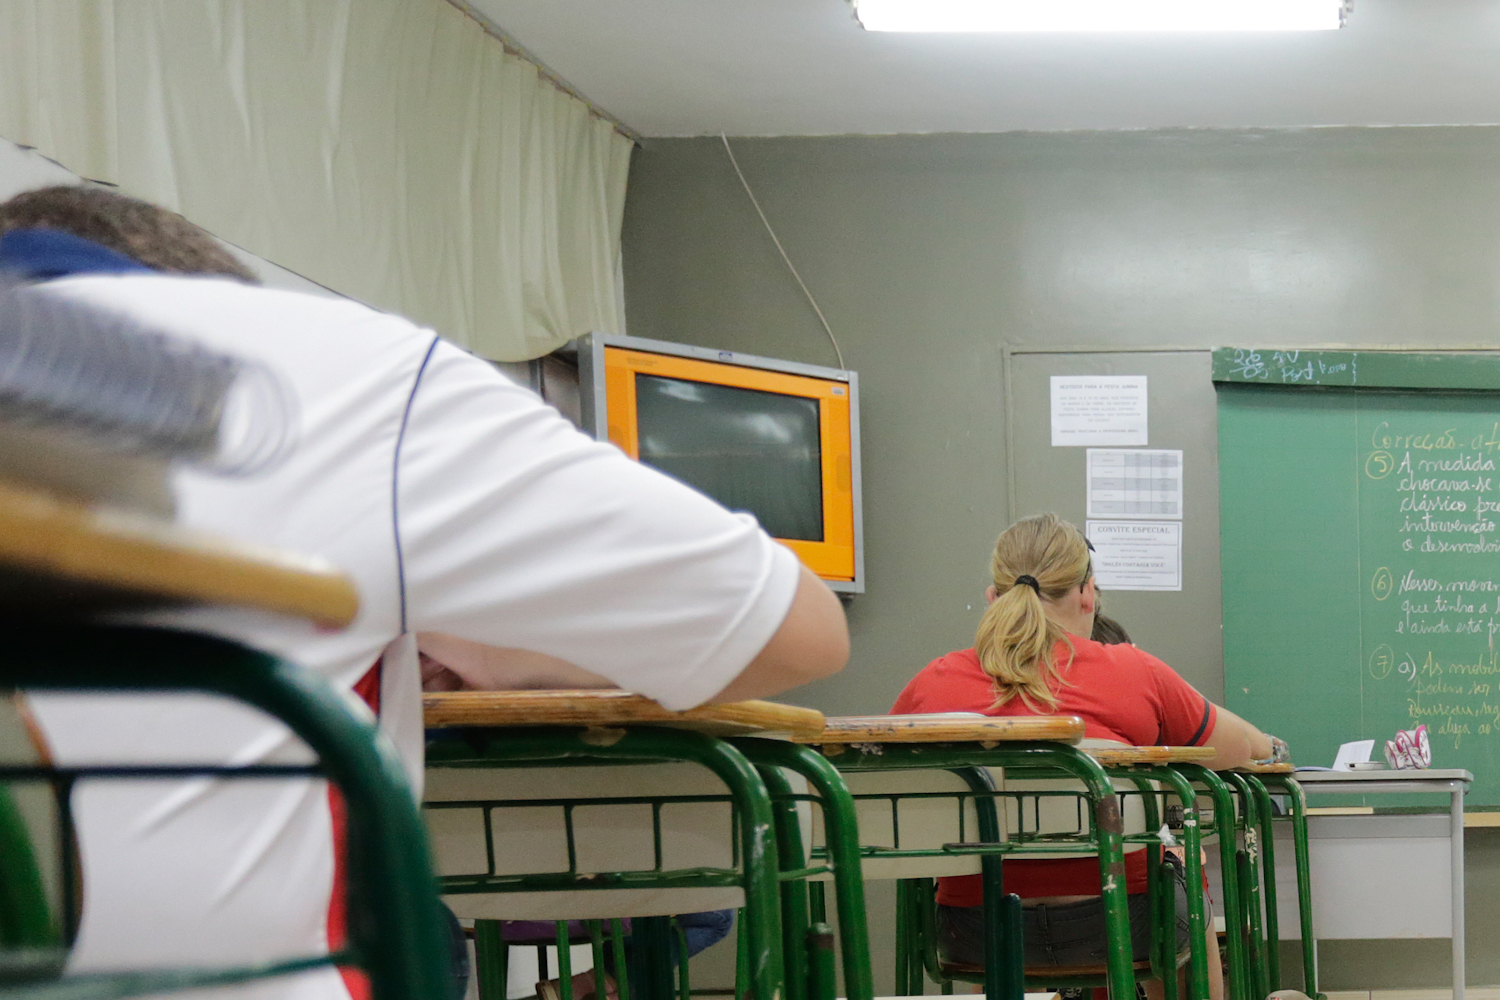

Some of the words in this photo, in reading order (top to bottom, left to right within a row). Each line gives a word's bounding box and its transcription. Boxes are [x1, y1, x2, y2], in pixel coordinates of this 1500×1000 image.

[1397, 451, 1411, 474] A
[1418, 452, 1496, 472] medida
[1398, 569, 1443, 595] Nesses
[1401, 600, 1429, 628] que
[1433, 594, 1474, 613] tinha
[1410, 617, 1450, 633] ainda
